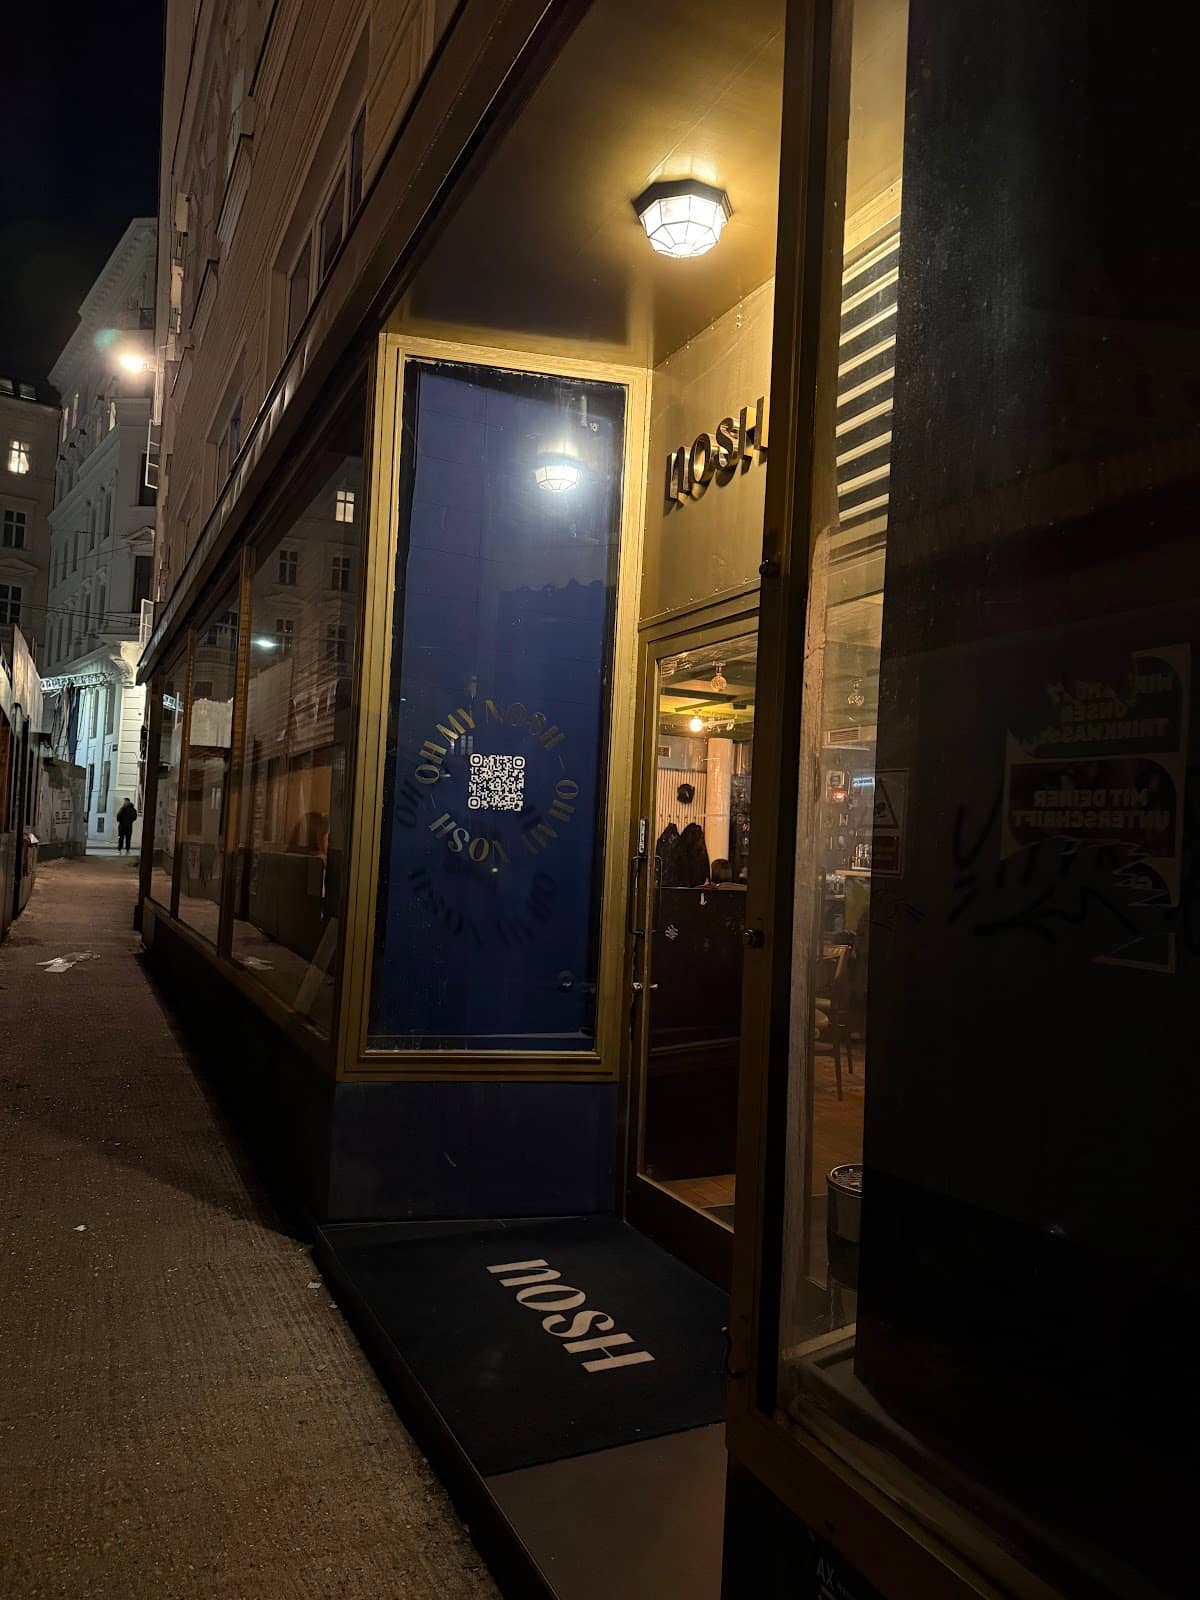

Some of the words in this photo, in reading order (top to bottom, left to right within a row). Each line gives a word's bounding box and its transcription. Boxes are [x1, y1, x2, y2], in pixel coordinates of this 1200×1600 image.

[415, 740, 447, 784] OH
[485, 699, 567, 751] NOSH
[548, 779, 579, 822] OH
[429, 812, 511, 864] NOSH
